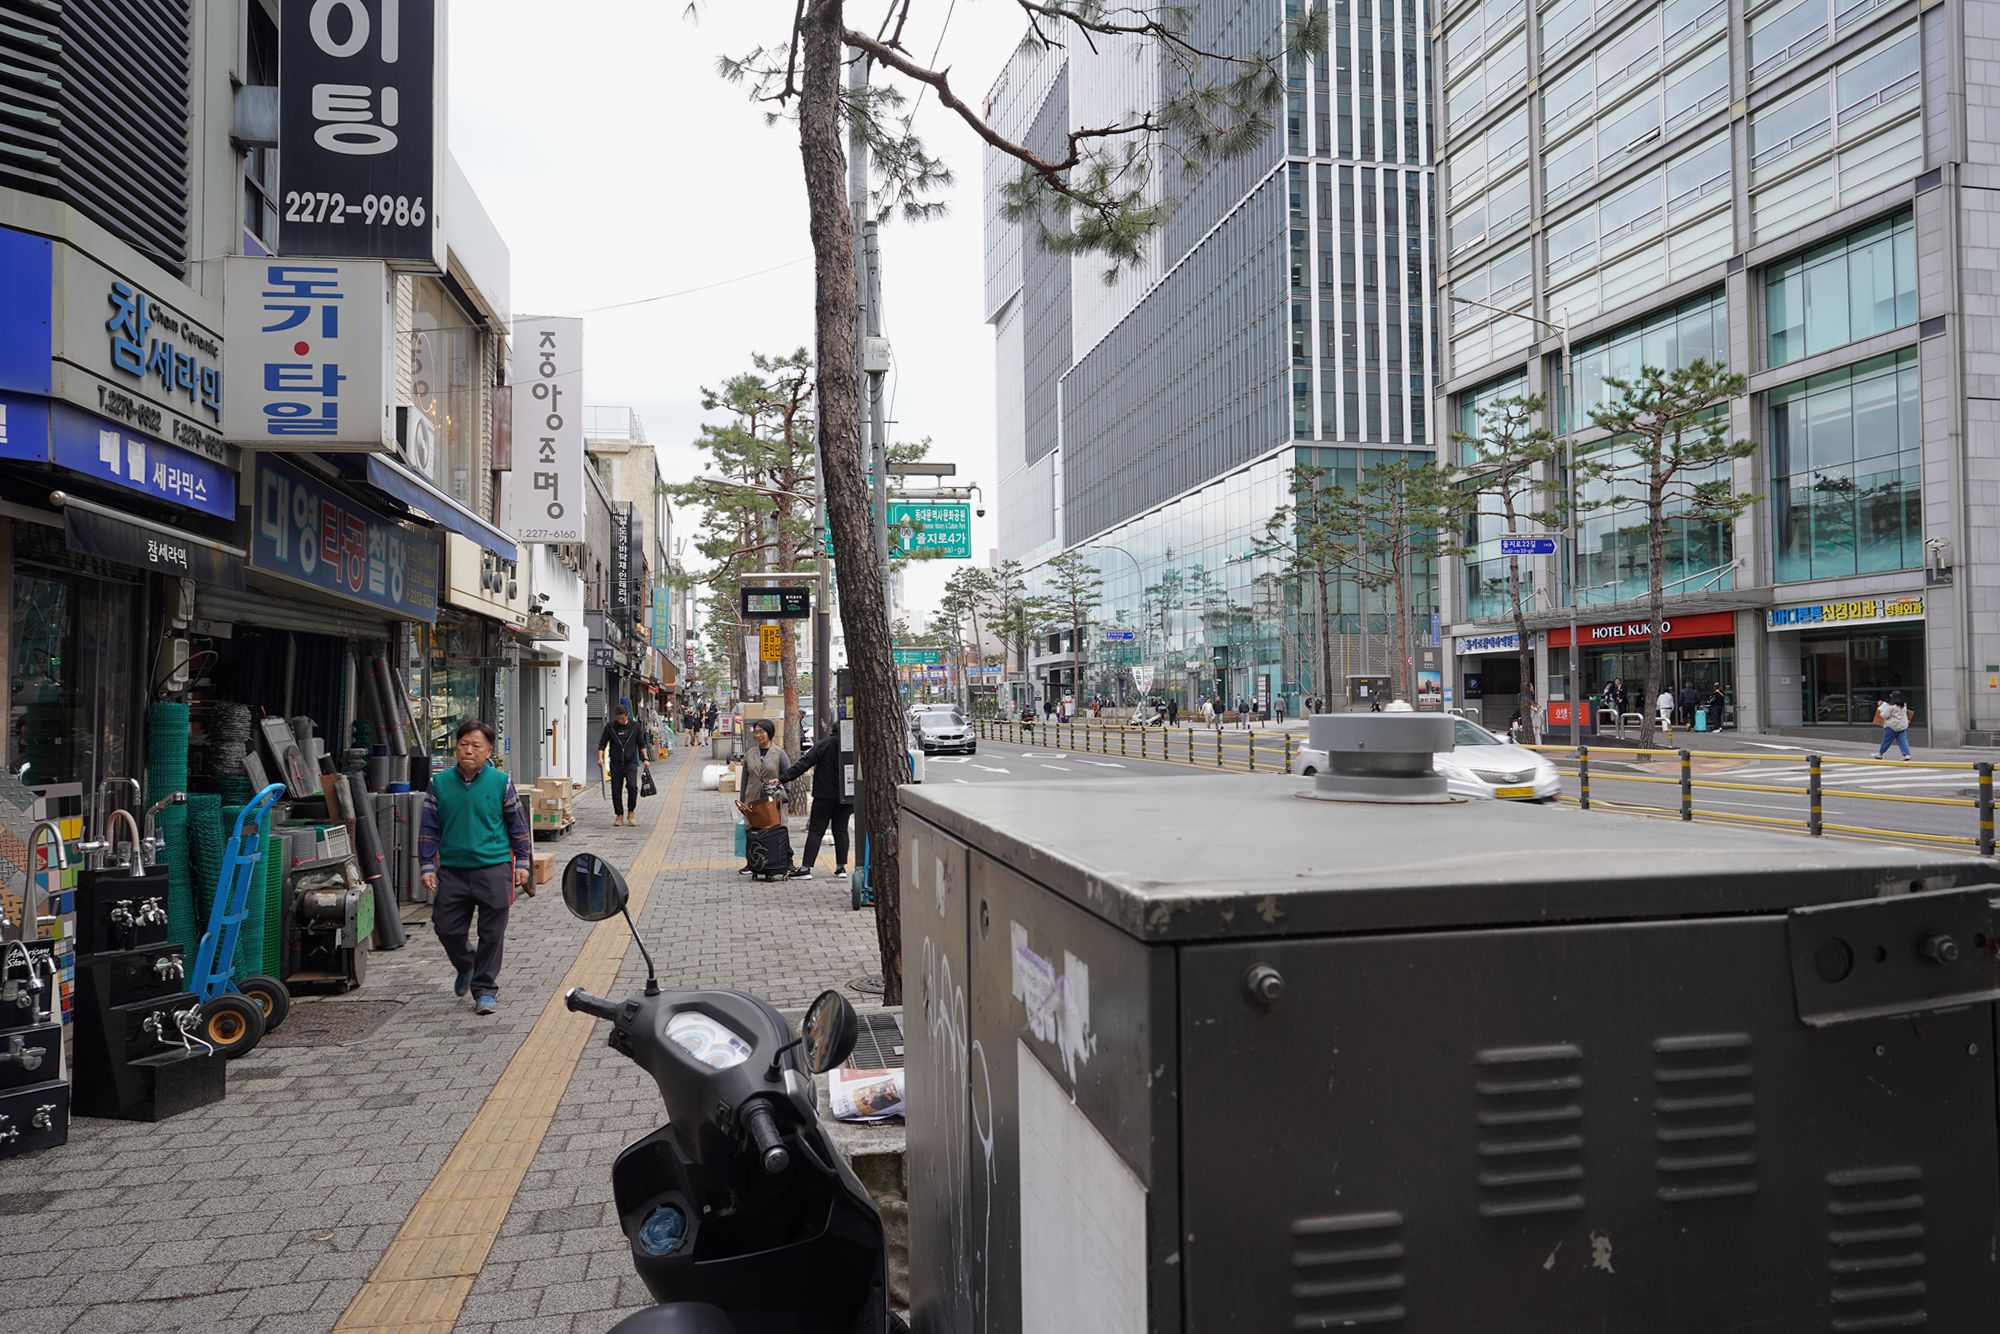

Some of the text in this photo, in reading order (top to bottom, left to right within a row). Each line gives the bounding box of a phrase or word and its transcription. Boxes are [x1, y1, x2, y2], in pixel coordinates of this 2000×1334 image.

[285, 191, 426, 227] 2272-9986
[105, 282, 223, 424] 참세라믹
[532, 331, 564, 520] 중앙조명
[153, 462, 207, 501] 세라믹스
[915, 509, 966, 522] 동대문역사문화공원
[518, 529, 577, 539] T.2277-6160
[916, 532, 966, 545] 을지로4가
[148, 540, 187, 569] 참세라믹
[1886, 602, 1923, 616] 정형외과
[1592, 621, 1671, 638] HOTEL KUKO
[1555, 708, 1568, 719] 호텔
